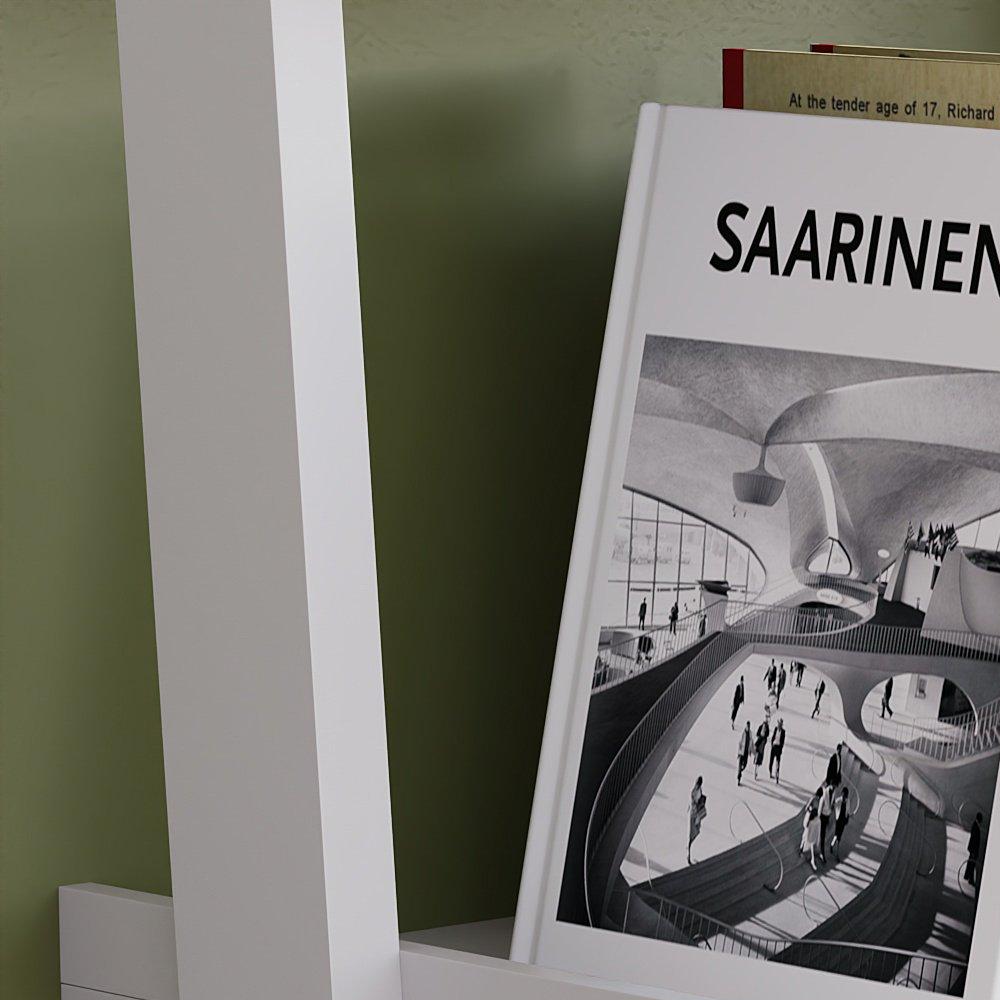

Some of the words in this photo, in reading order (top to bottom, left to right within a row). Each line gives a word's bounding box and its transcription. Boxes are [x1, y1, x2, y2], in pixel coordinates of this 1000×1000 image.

[789, 92, 802, 108] At
[807, 94, 827, 110] the
[831, 96, 870, 113] tender
[876, 101, 899, 118] age
[904, 100, 917, 116] of
[922, 101, 942, 120] 17,
[947, 102, 995, 121] Richard
